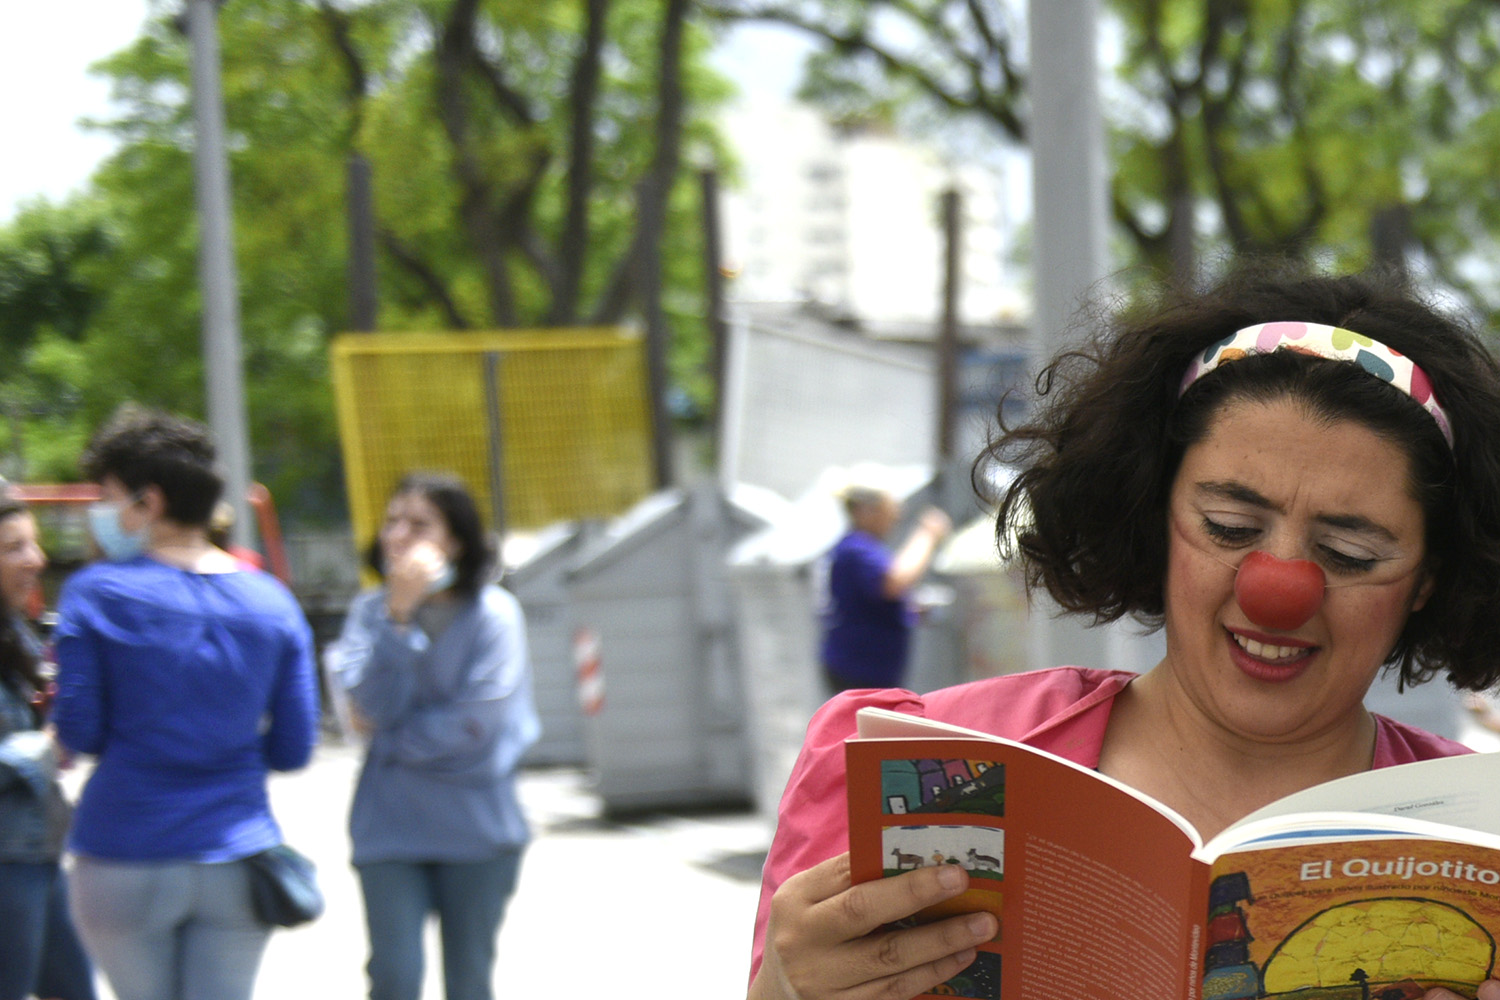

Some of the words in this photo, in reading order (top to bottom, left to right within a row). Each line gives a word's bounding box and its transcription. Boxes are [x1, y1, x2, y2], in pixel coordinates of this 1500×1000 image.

[1300, 860, 1332, 881] El
[1342, 857, 1500, 885] Quijotito
[1413, 884, 1430, 892] por
